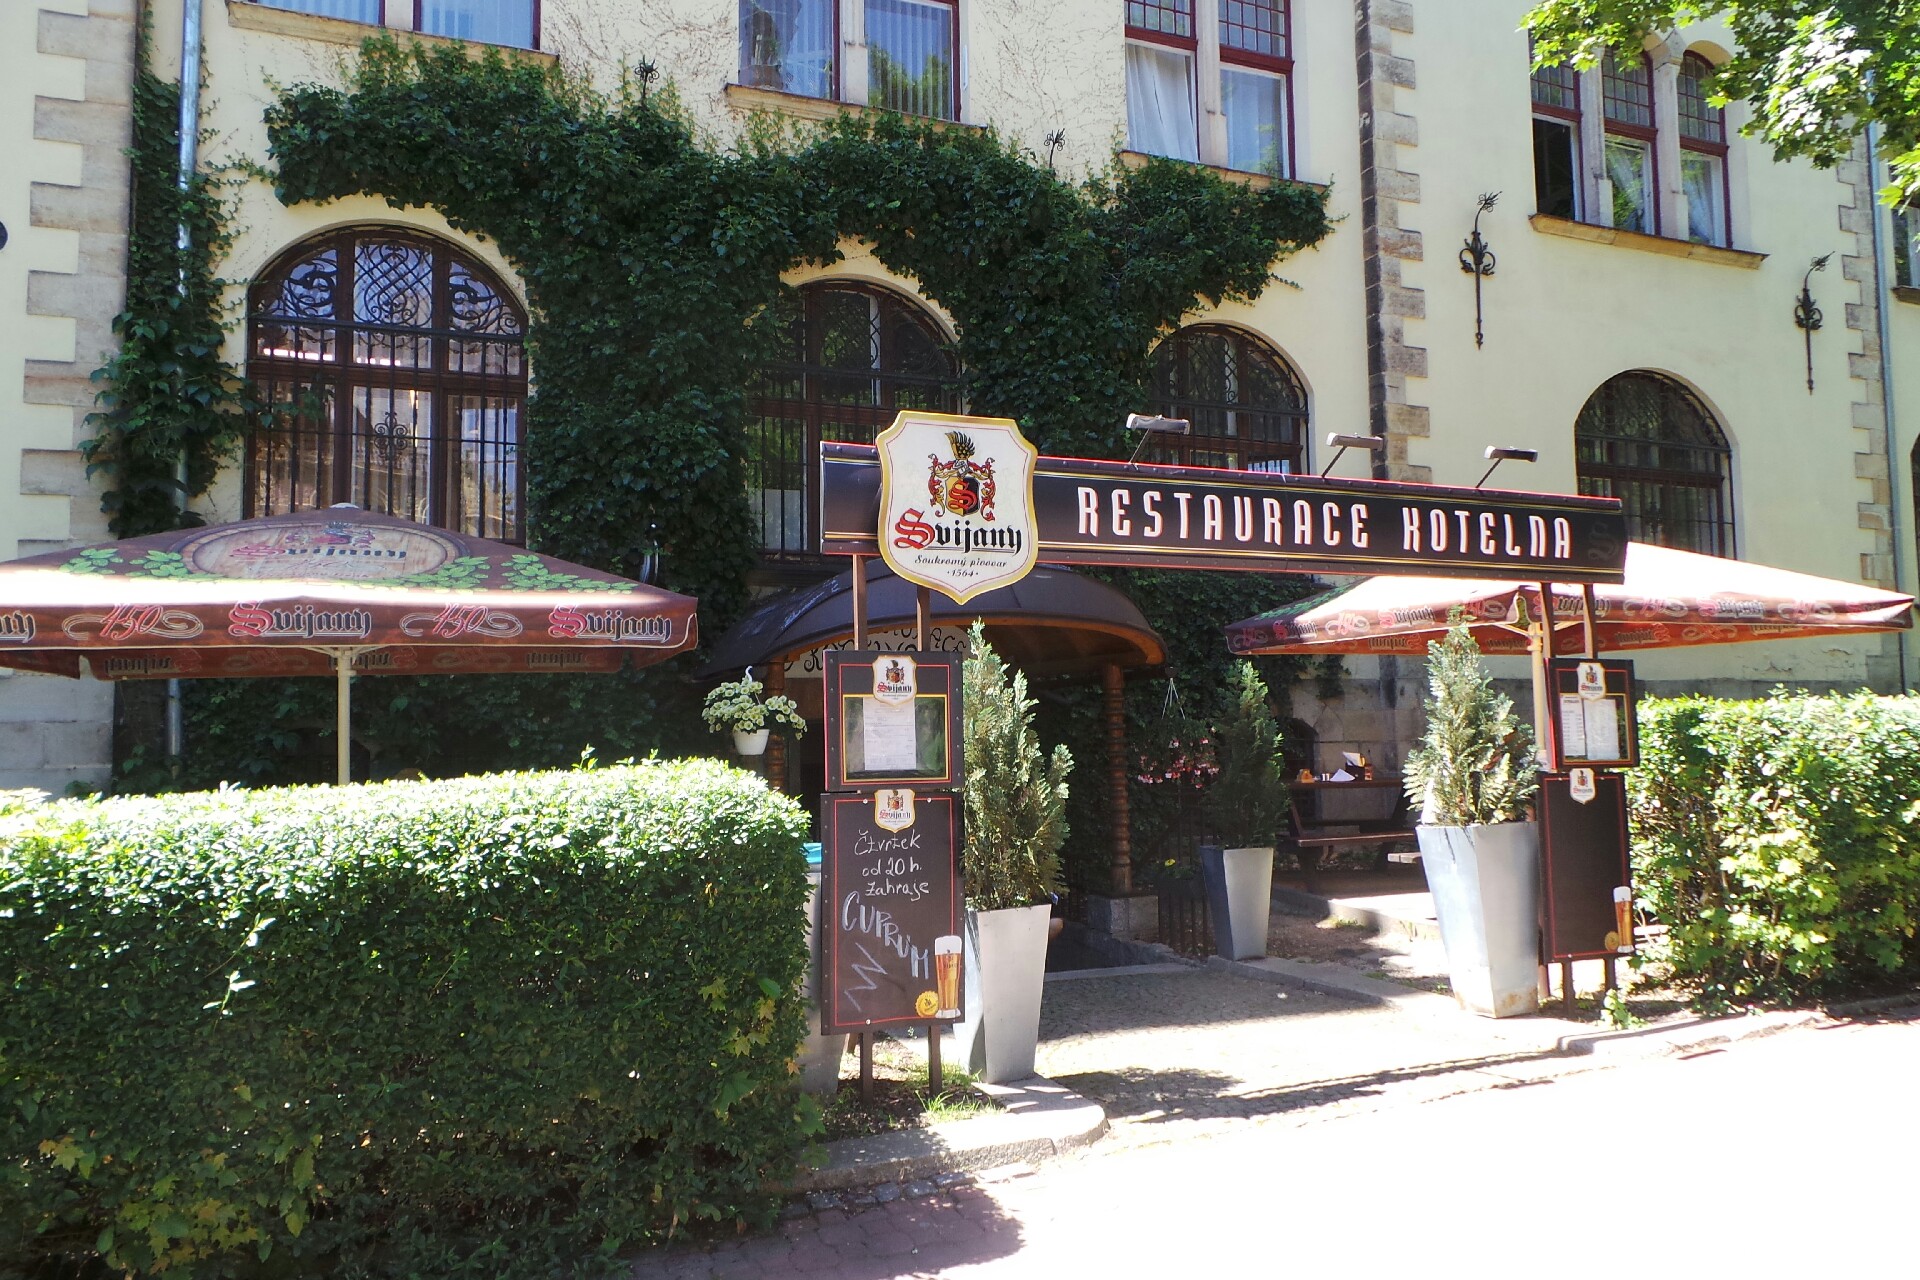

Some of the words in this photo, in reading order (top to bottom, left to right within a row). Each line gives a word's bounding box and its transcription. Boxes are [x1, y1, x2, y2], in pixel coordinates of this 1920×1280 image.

[894, 508, 1022, 556] Svijany
[1077, 486, 1369, 549] RESTAURACE
[1401, 506, 1572, 559] KOTELNA
[914, 554, 967, 568] Soukromý
[969, 556, 1008, 569] pivovar
[228, 599, 372, 639] Svijany
[548, 602, 672, 643] Svijany
[877, 681, 912, 693] Svijany
[854, 828, 921, 856] Čtvrtek
[862, 858, 882, 877] od
[885, 856, 906, 877] 20
[841, 890, 929, 980] CUPRUM
